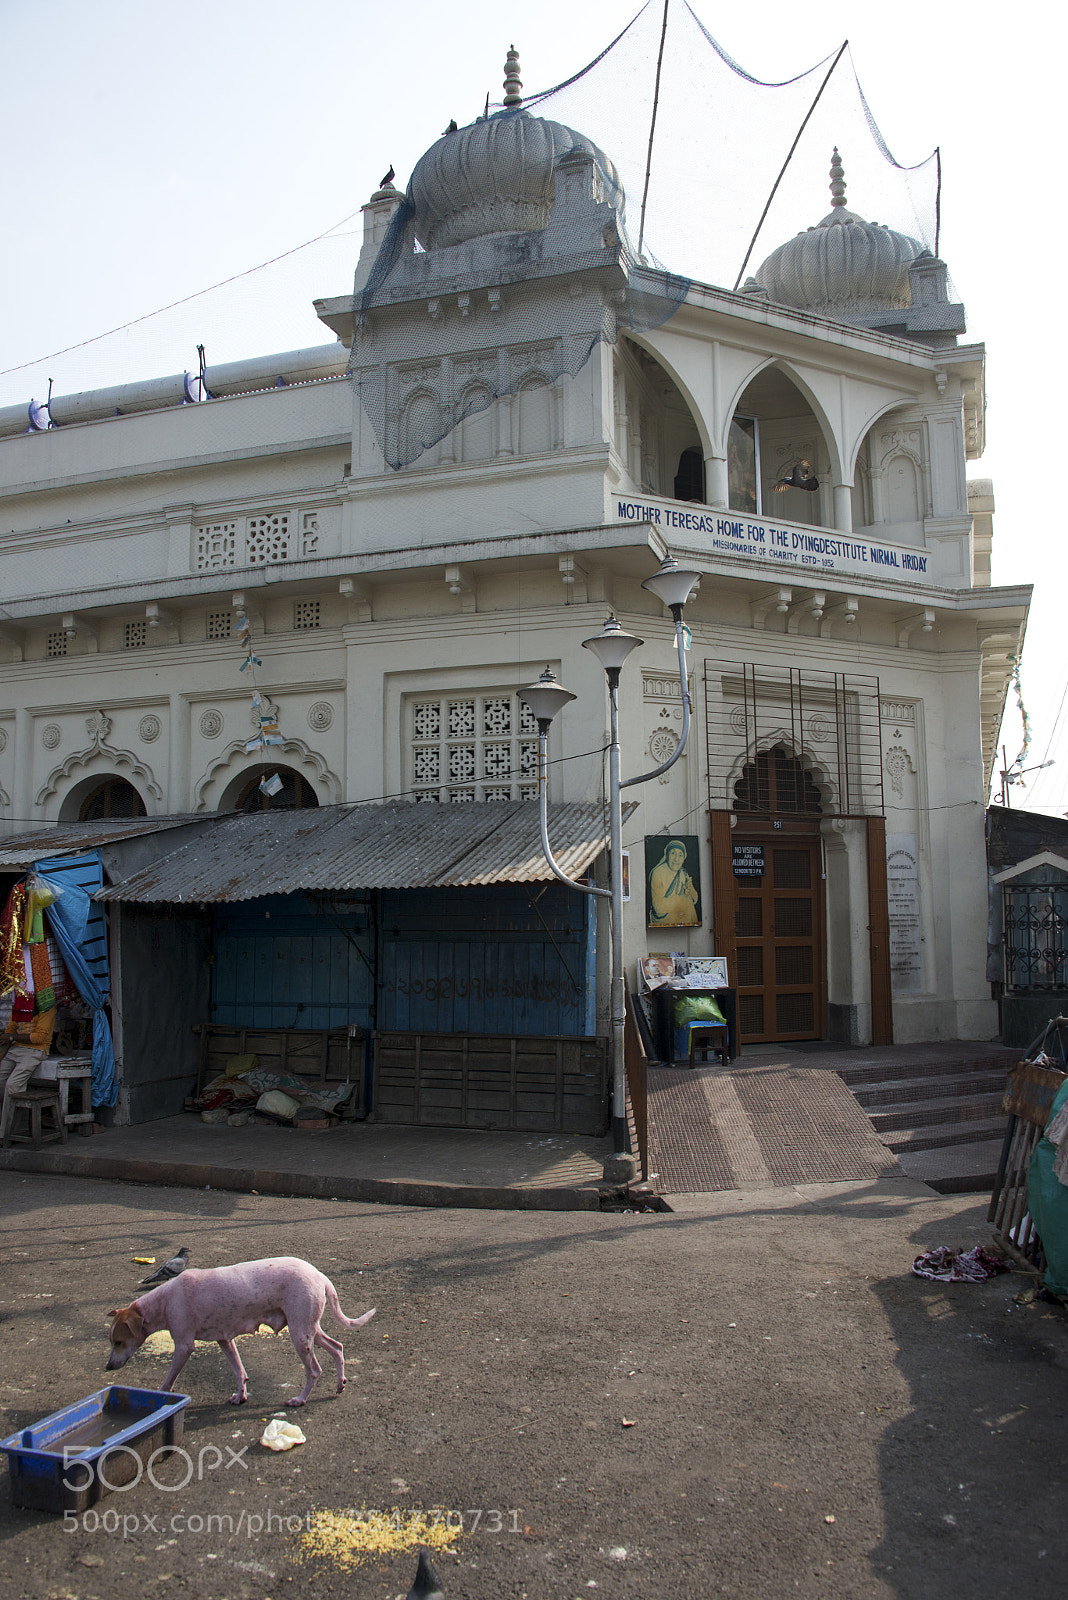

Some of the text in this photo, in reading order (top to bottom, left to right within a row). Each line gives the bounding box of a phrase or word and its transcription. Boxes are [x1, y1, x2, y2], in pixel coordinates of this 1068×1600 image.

[617, 501, 662, 525] MOTHER
[664, 509, 714, 533] TERESA'S
[717, 519, 745, 539] HOME
[747, 524, 766, 543] FOR
[769, 529, 789, 547] THE
[870, 547, 900, 568] NIRMAL
[901, 553, 928, 573] HRIDAY
[712, 538, 757, 555] MISSIONARIES
[758, 547, 767, 556] OF
[769, 548, 798, 562] CHARITY
[734, 846, 762, 854] NO VISITORS
[732, 858, 748, 867] ALLOWED
